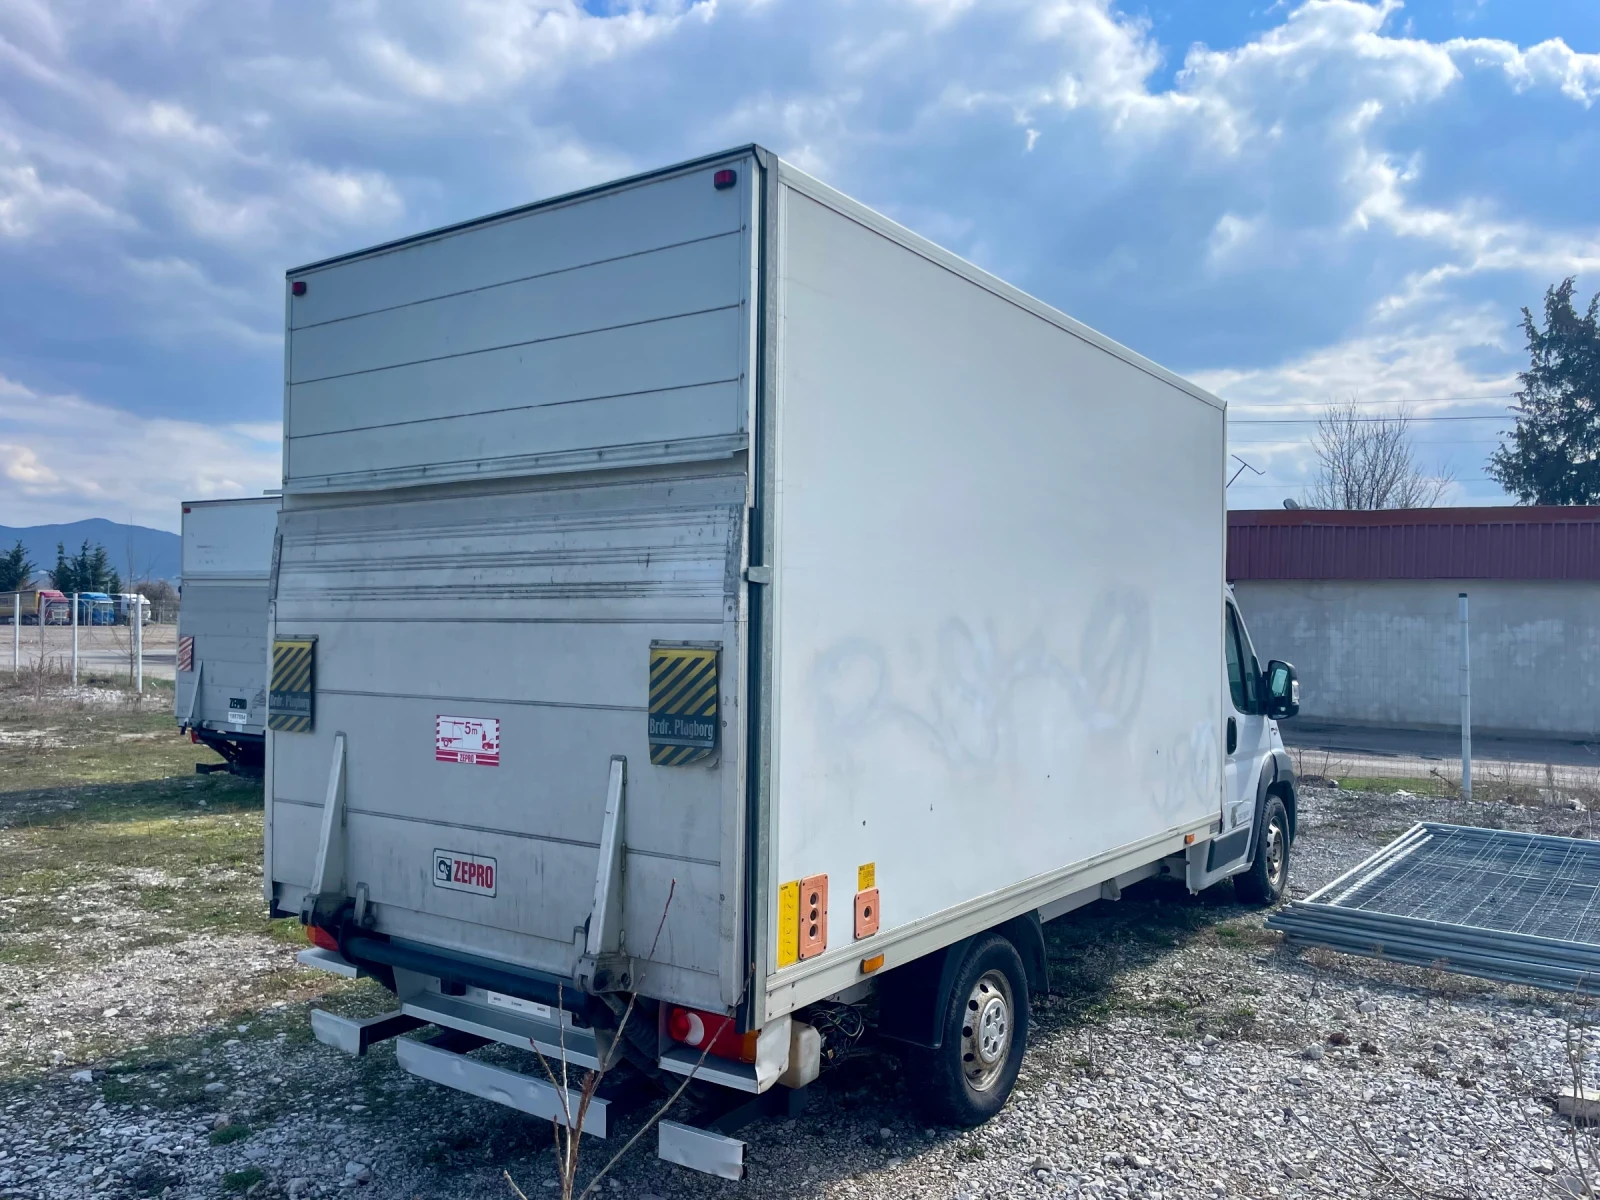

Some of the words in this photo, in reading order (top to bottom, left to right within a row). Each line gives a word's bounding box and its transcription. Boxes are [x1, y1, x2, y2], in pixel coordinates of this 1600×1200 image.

[649, 718, 672, 735] Brdr.
[674, 719, 714, 740] Plagborg
[459, 753, 475, 763] ZEPRO
[453, 860, 494, 889] ZEPRO
